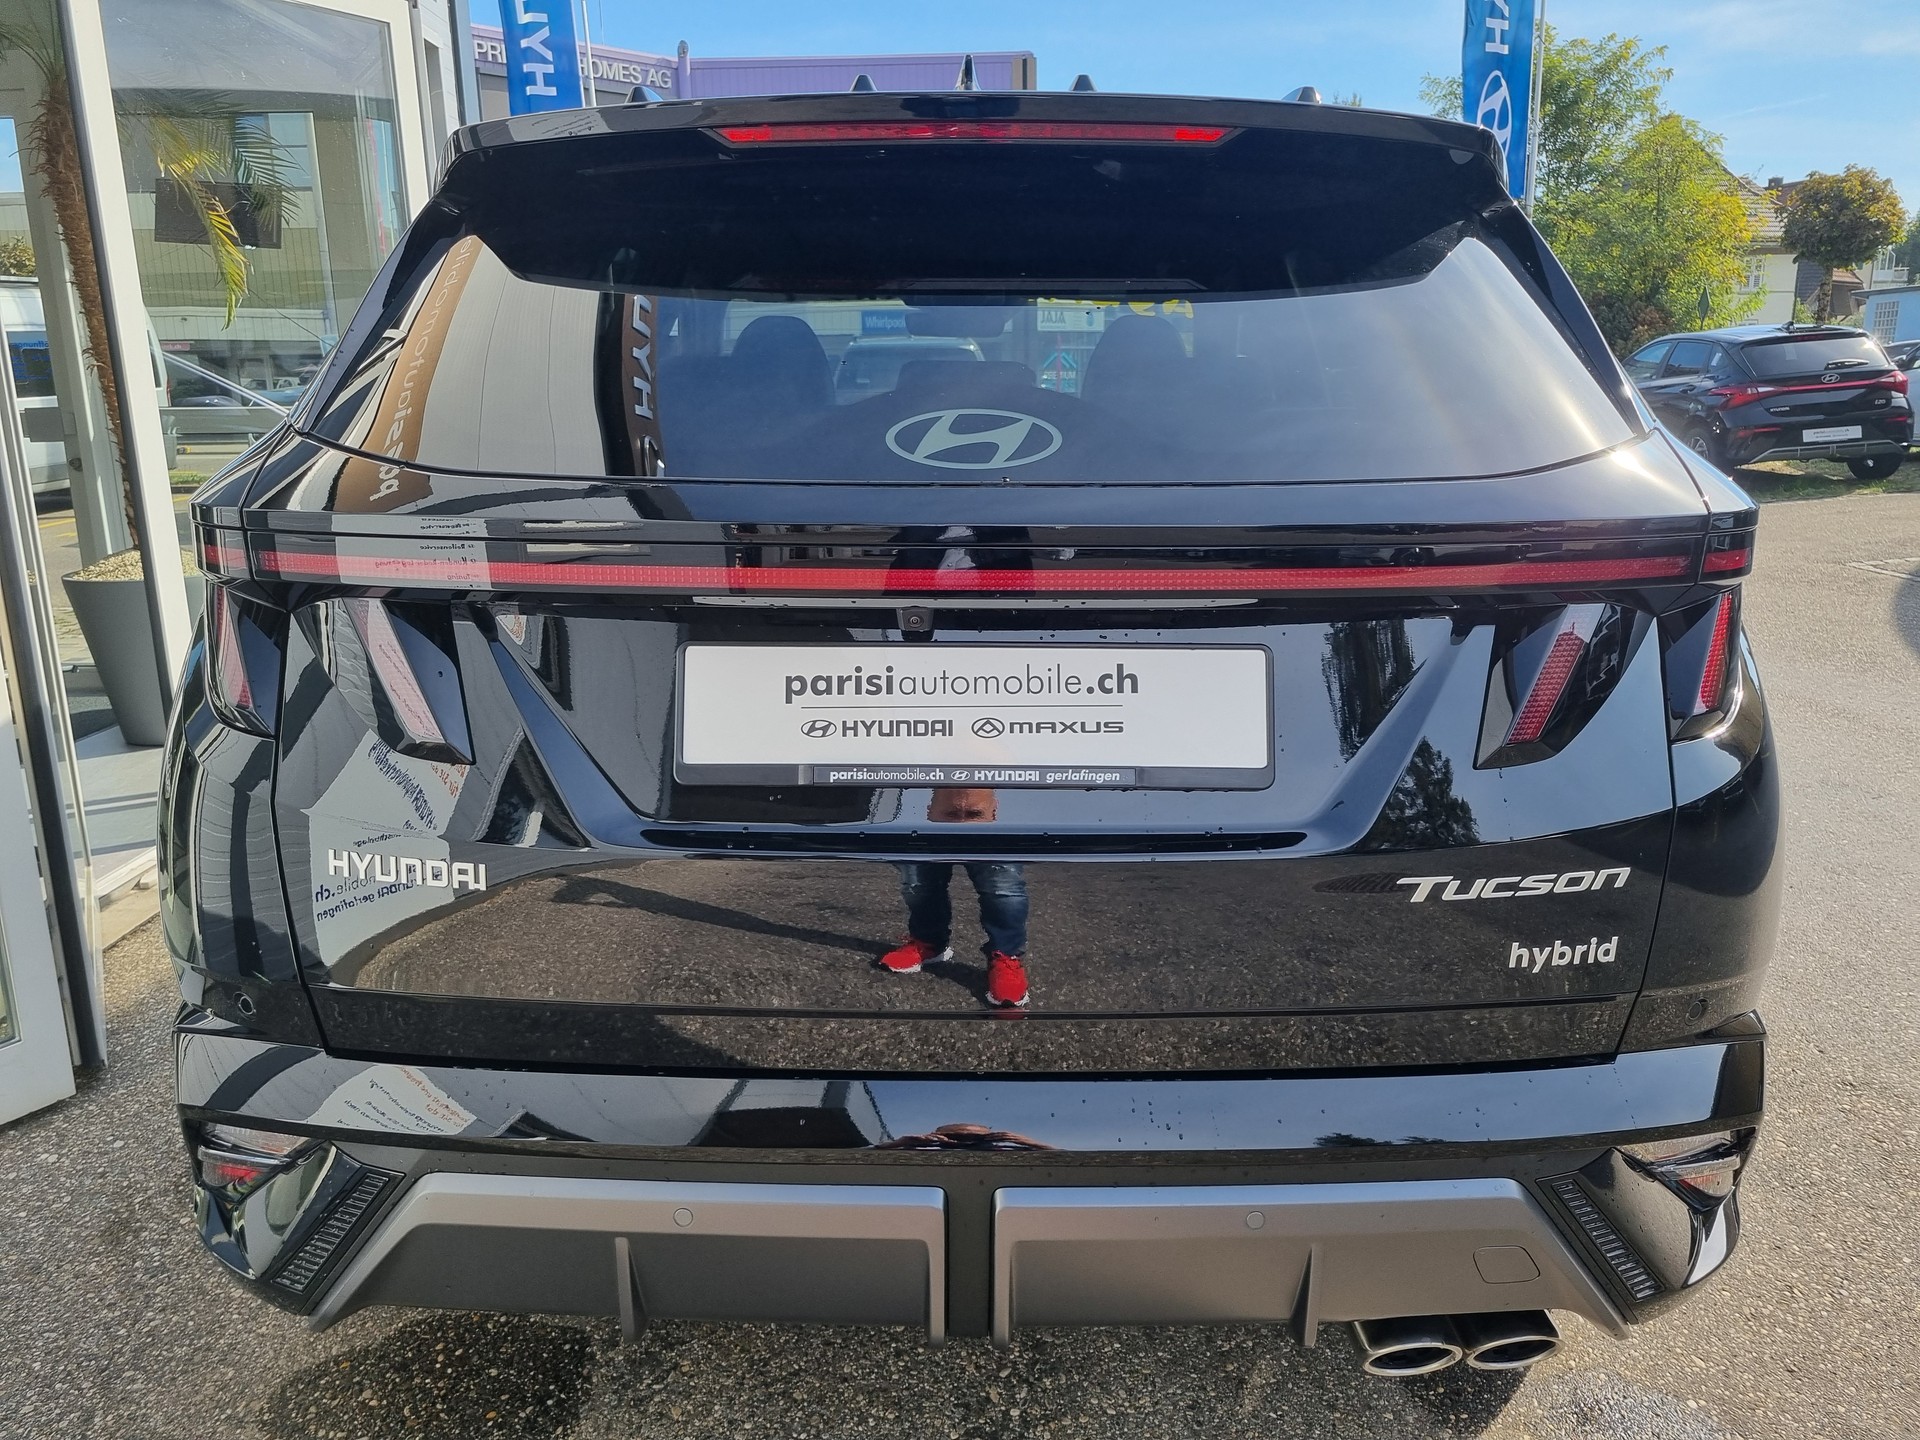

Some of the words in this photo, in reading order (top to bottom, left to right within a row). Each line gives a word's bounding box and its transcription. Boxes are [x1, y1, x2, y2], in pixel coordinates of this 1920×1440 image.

[646, 69, 672, 89] AG
[784, 663, 1139, 705] parisiautomobile.ch
[841, 719, 954, 738] HYUNDAI
[1009, 721, 1124, 734] MAXUS
[829, 767, 945, 783] parisiautomobile.ch
[974, 770, 1040, 782] HYUNDAI
[1046, 769, 1120, 784] gerlafingen
[327, 848, 488, 891] HYUNDAI
[1508, 936, 1620, 974] hybrid
